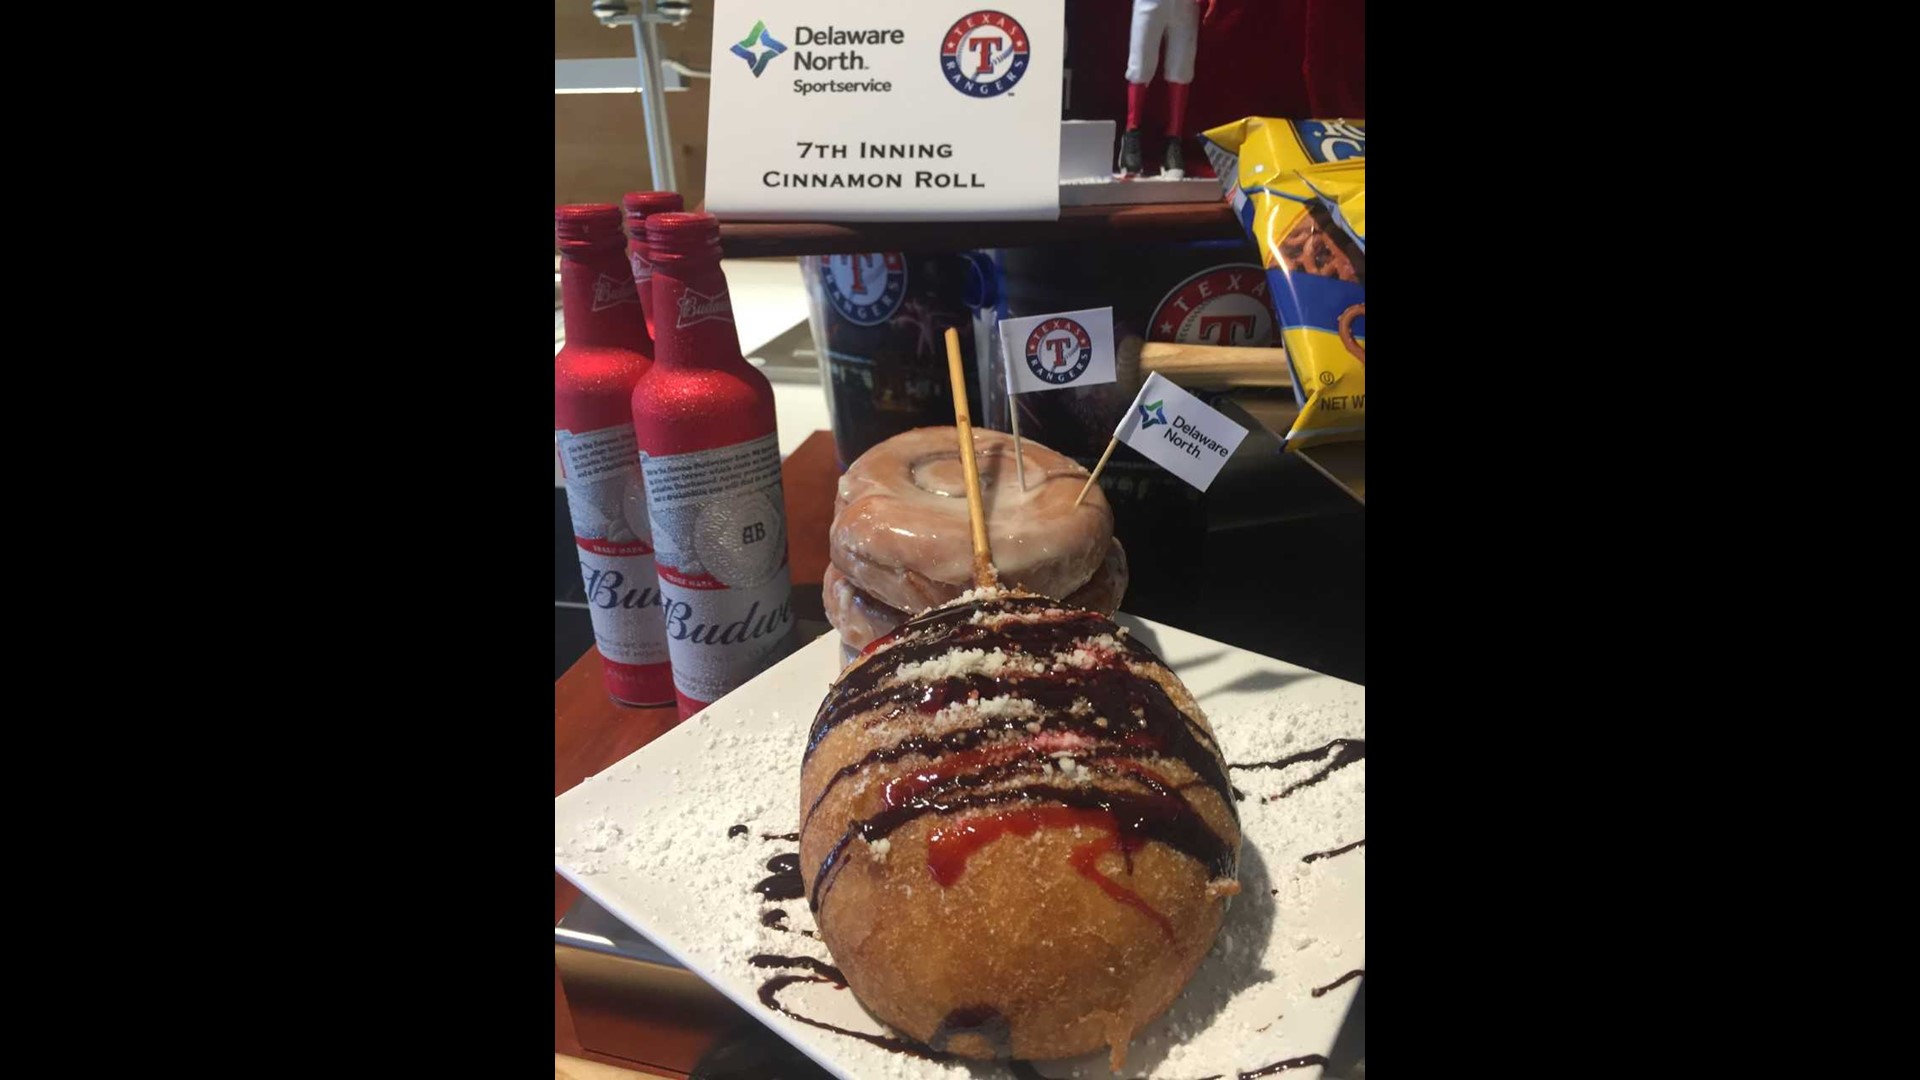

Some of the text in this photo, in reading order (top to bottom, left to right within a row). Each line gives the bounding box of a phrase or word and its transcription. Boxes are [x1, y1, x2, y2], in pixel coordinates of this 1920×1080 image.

[795, 25, 905, 46] Delaware
[953, 14, 1018, 36] TEXAS
[794, 50, 865, 70] North
[969, 37, 1003, 74] T
[793, 78, 892, 96] Sportservice
[946, 60, 1023, 95] RANGERS
[1173, 274, 1266, 313] TEXA
[1033, 320, 1081, 340] TEXAS
[1046, 337, 1071, 366] T
[1030, 353, 1088, 381] RANGERS
[1321, 396, 1349, 410] NET
[1163, 428, 1202, 458] North
[1172, 415, 1229, 458] Delaware
[580, 560, 661, 610] Bu
